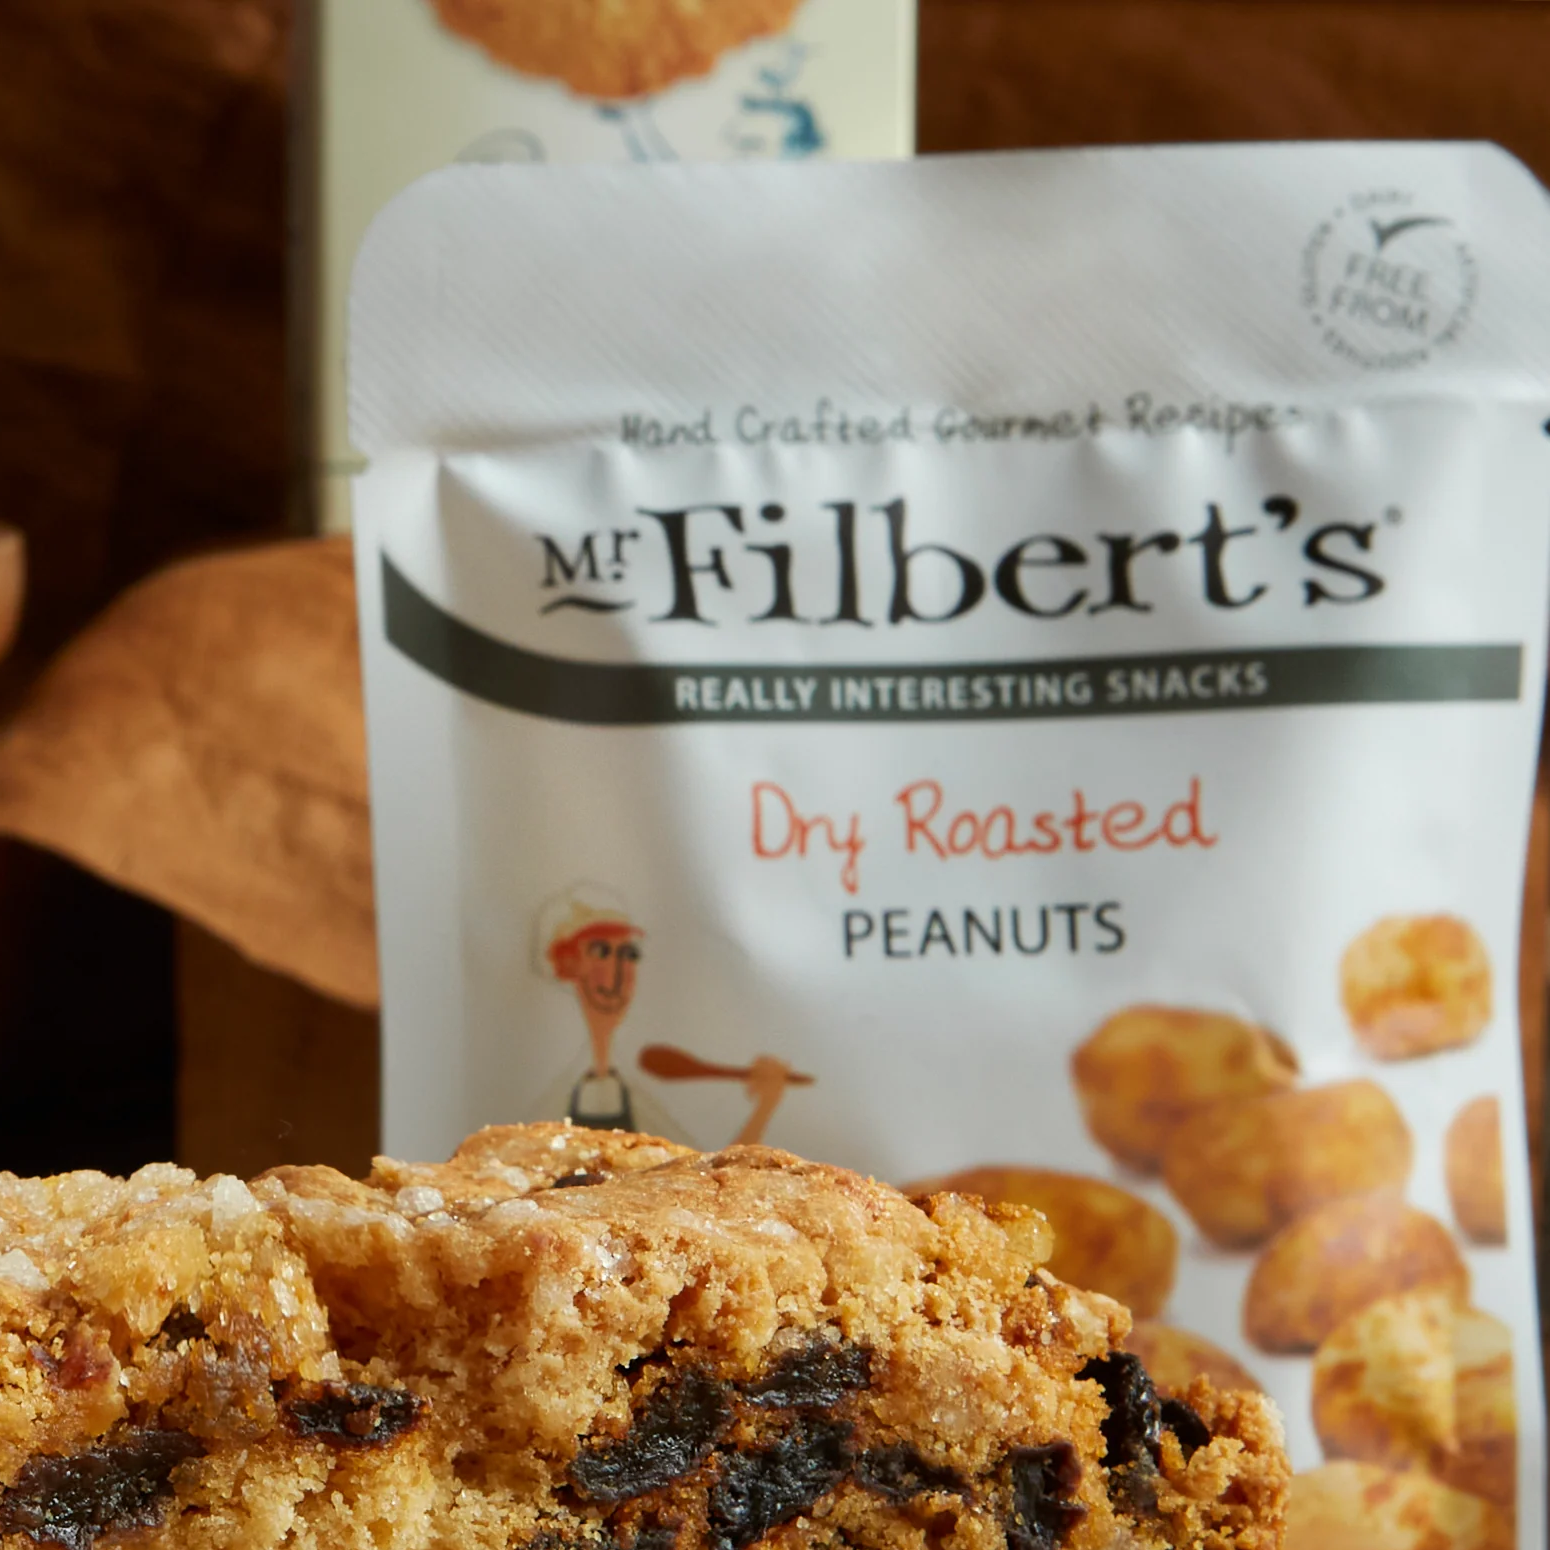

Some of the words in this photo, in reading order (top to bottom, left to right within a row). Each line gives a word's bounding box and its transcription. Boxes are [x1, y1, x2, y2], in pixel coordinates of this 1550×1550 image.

[1346, 251, 1432, 301] FREE
[1327, 283, 1431, 338] FROM
[621, 412, 716, 448] Hand
[736, 399, 914, 446] Crafted
[637, 493, 1386, 628] Filbert's
[675, 676, 817, 711] REALLY
[830, 671, 1093, 711] INTERESTING
[1106, 662, 1268, 701] SNACKS
[750, 782, 865, 894] Dry
[895, 776, 1218, 860] Roasted
[843, 902, 1126, 960] PEANUTS
